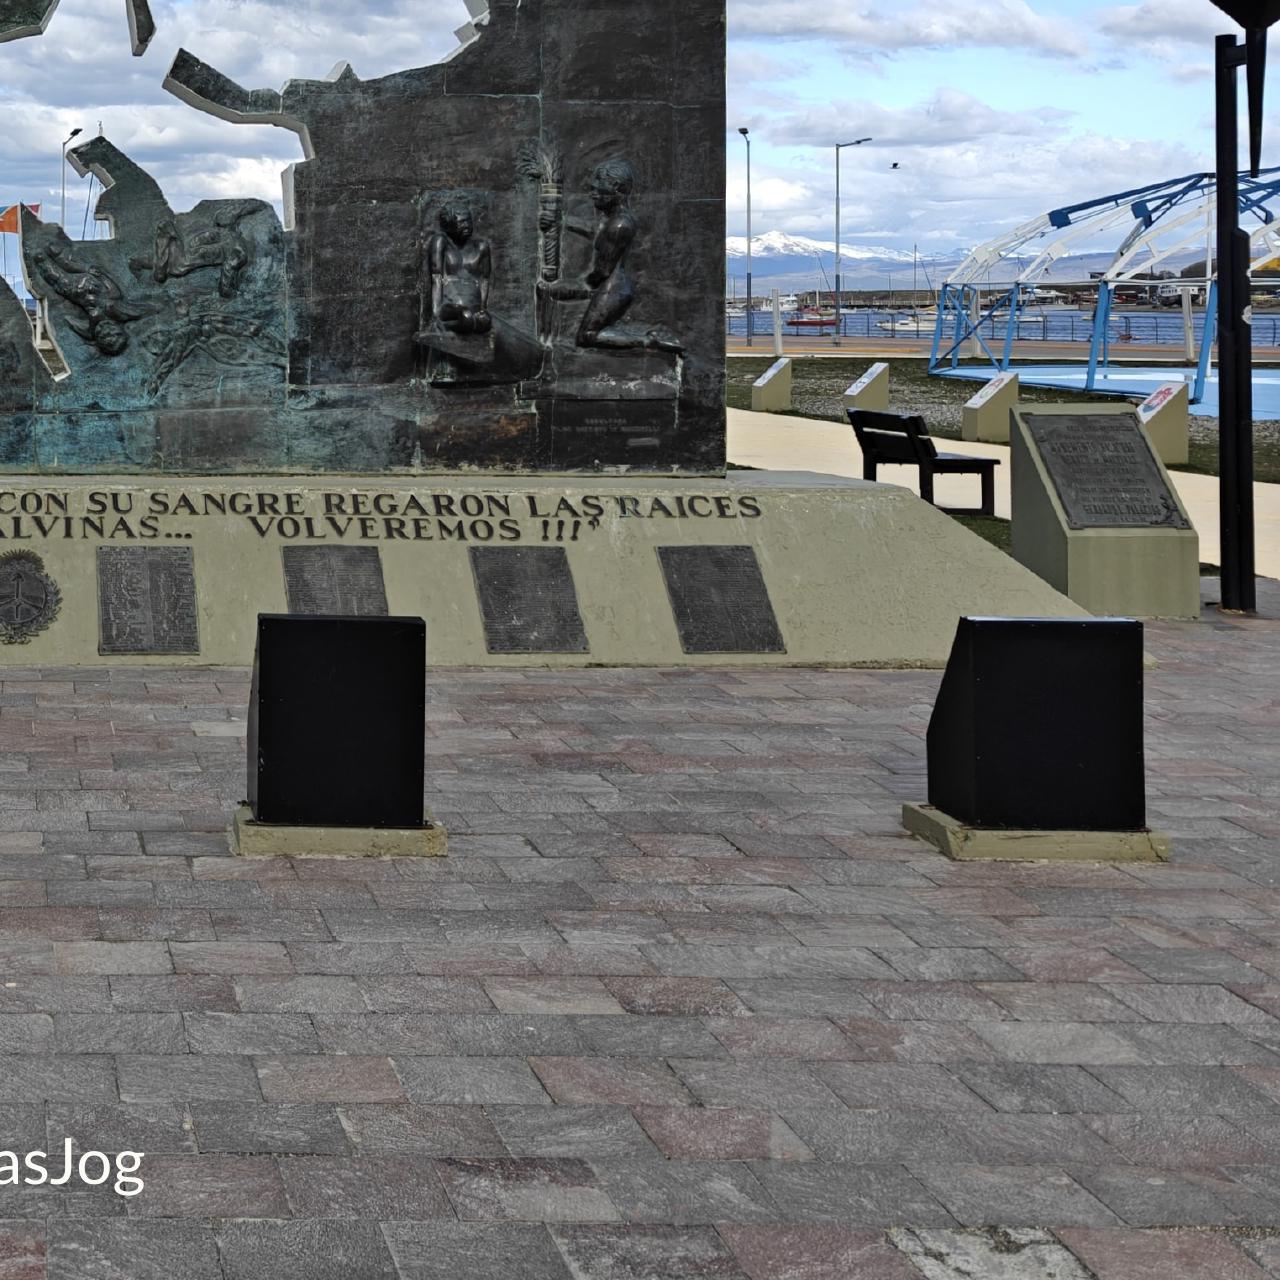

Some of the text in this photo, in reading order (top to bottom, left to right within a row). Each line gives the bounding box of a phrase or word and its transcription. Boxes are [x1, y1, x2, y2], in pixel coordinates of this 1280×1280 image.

[87, 492, 133, 515] SU
[148, 492, 305, 516] SANGRE
[323, 493, 511, 518] REGARON
[527, 495, 604, 518] LAS
[615, 495, 761, 519] RAICES
[247, 516, 521, 542] VOLVEREMOS
